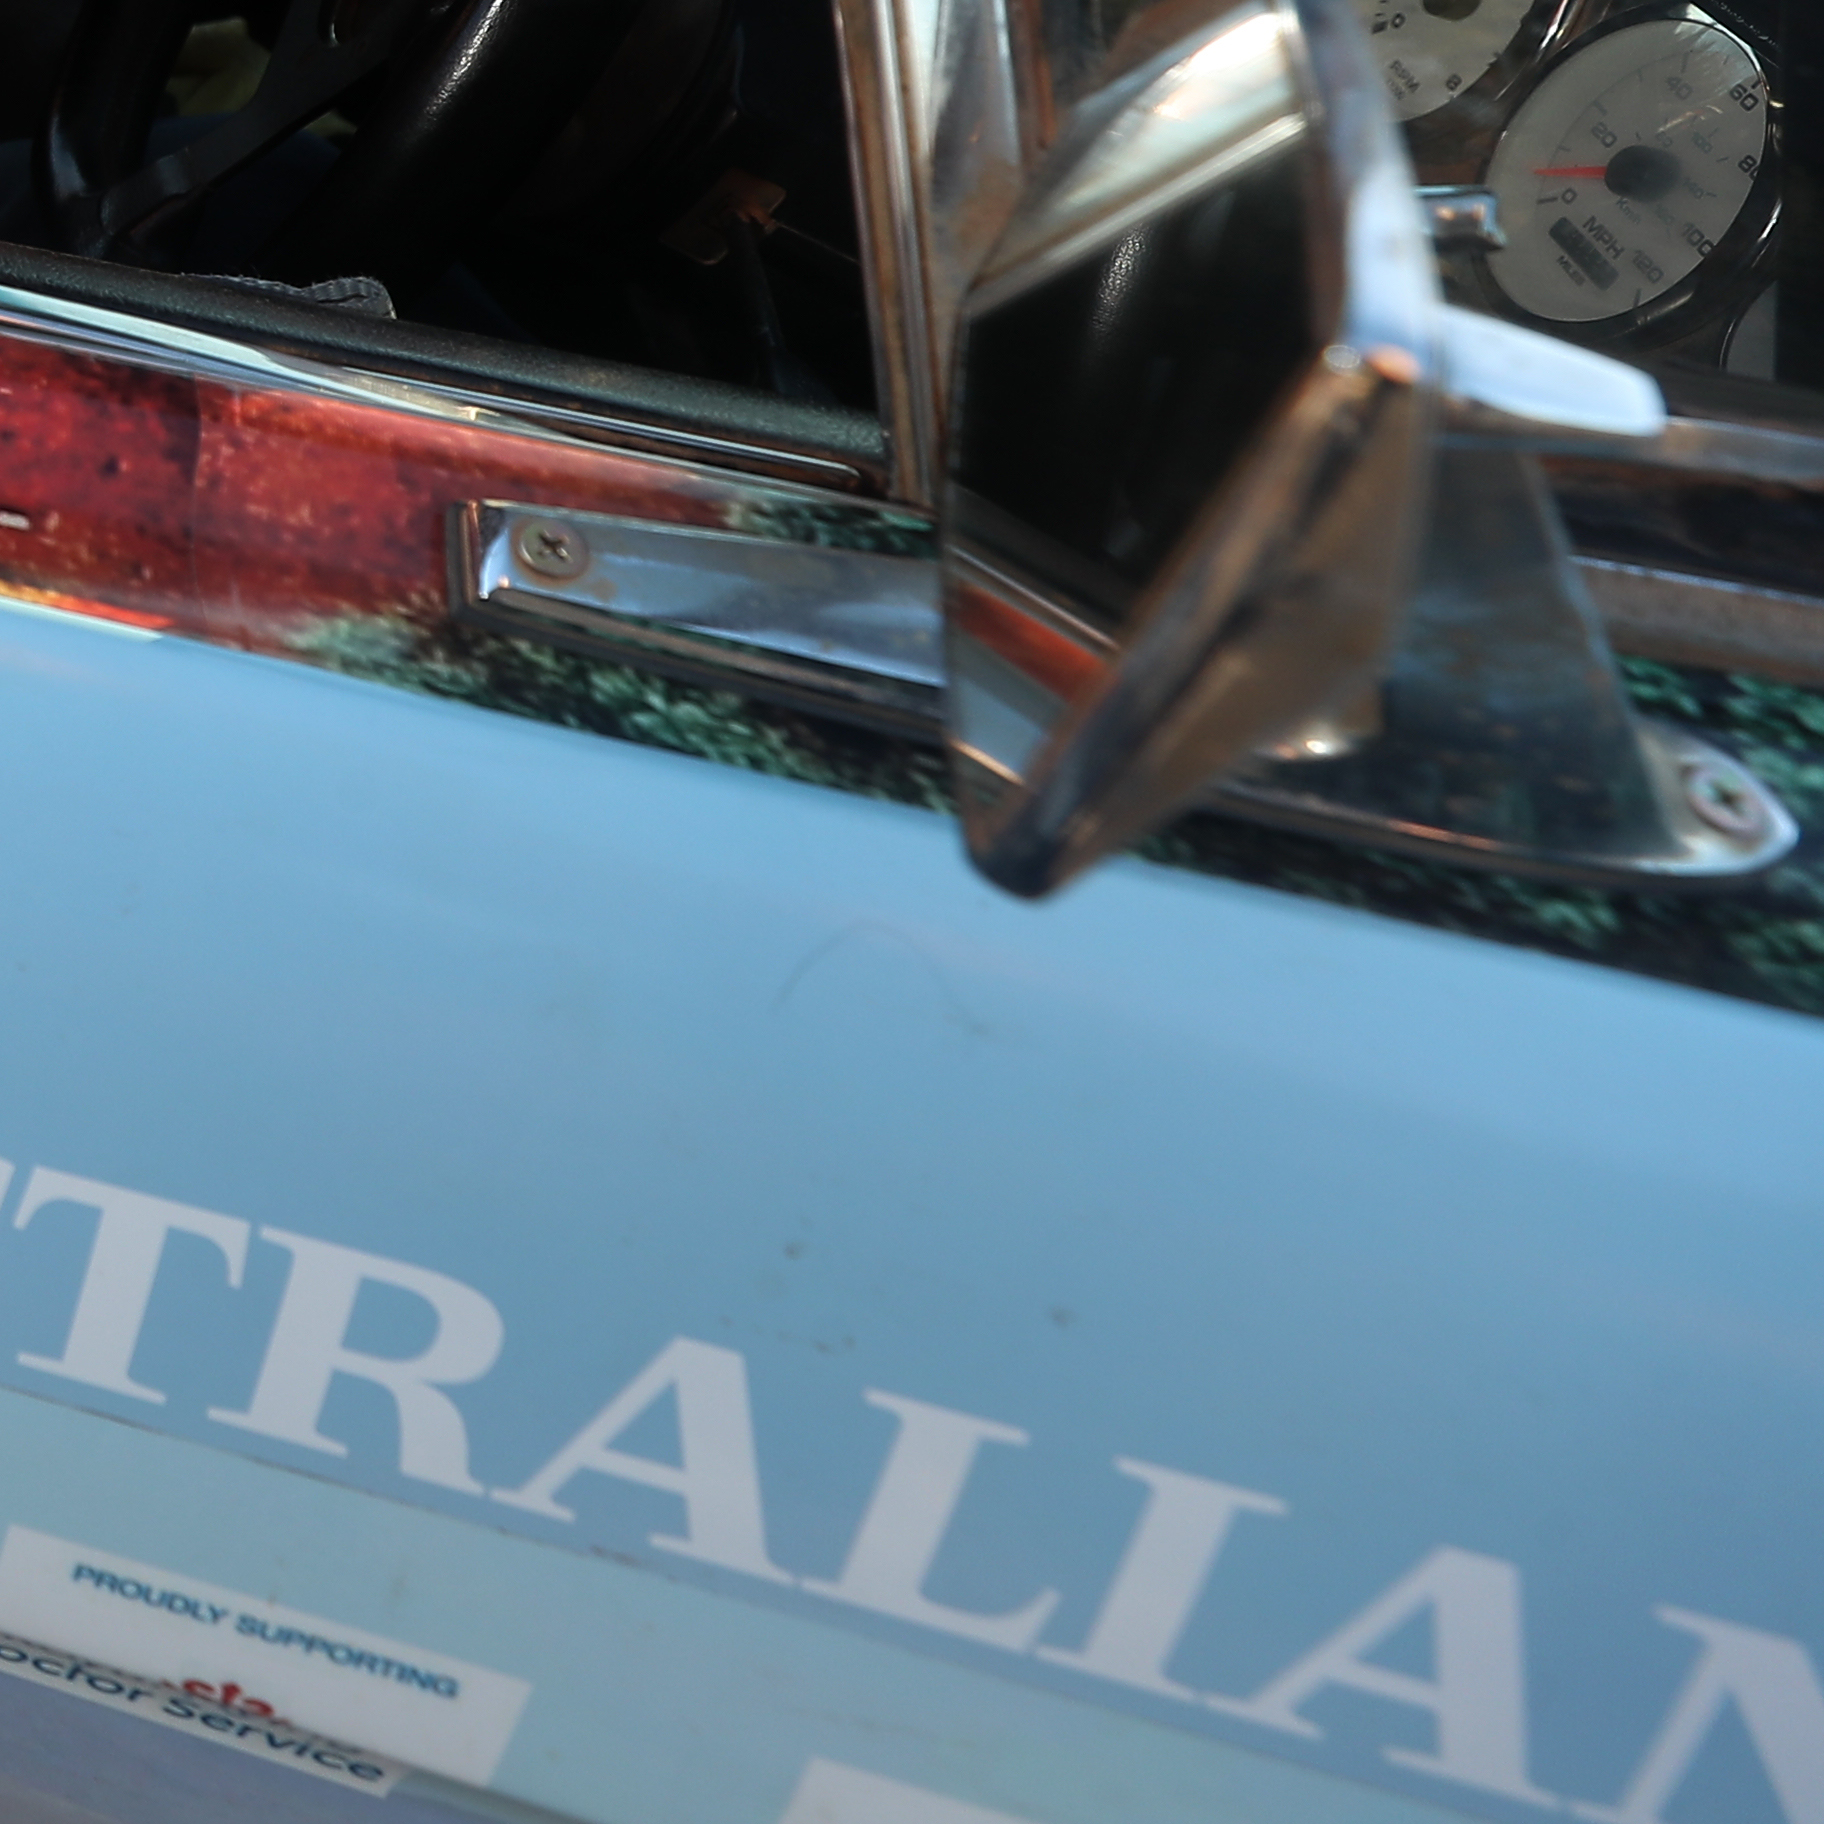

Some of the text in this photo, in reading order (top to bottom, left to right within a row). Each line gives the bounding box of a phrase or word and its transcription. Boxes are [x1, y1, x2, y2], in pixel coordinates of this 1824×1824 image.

[1728, 83, 1760, 113] 60
[1590, 122, 1618, 149] 20
[1581, 215, 1625, 261] MPH
[1681, 222, 1717, 259] 100
[70, 1562, 230, 1626] PROUDLY
[233, 1612, 461, 1699] SUPPORTING
[162, 1696, 385, 1782] Service
